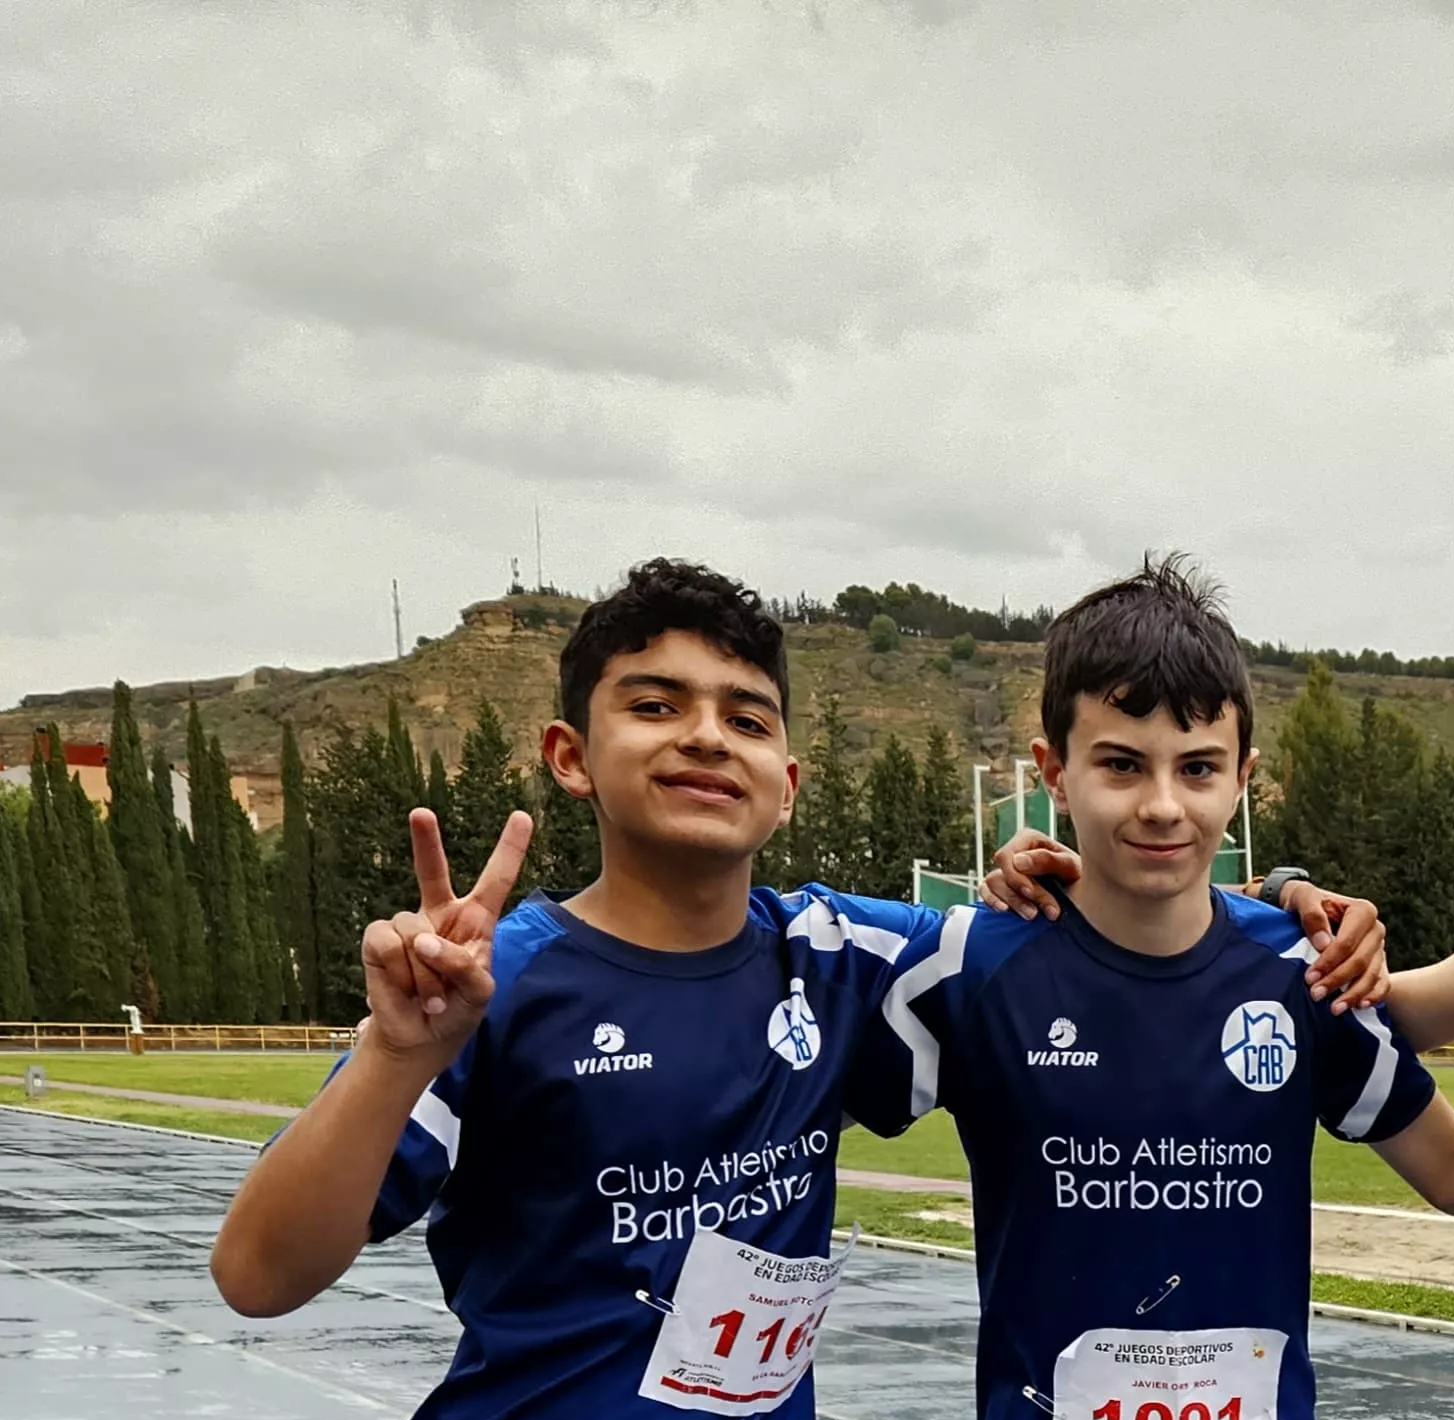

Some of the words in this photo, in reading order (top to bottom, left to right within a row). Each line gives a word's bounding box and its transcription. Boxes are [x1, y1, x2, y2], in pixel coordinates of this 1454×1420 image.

[574, 1053, 653, 1076] VIATOR
[1027, 1051, 1098, 1066] VIATOR
[1244, 1045, 1283, 1085] CAB
[1042, 1136, 1120, 1166] Club
[1131, 1138, 1272, 1167] Atletismo
[597, 1161, 684, 1196] Club
[1055, 1170, 1263, 1210] Barbastro
[612, 1172, 812, 1243] Barbastro
[761, 1258, 805, 1274] JUEGOS
[754, 1267, 773, 1280] EN
[774, 1273, 802, 1284] EDAD
[748, 1293, 788, 1307] SAMUEL
[1117, 1343, 1164, 1355] JUEGOS
[1166, 1342, 1233, 1356] DEPORTIVOS
[1115, 1354, 1130, 1363] EN
[1134, 1354, 1165, 1365] EDAD
[1169, 1354, 1216, 1366] ESCOLAR
[1132, 1380, 1168, 1390] JAVIER
[1194, 1379, 1217, 1388] ROCA
